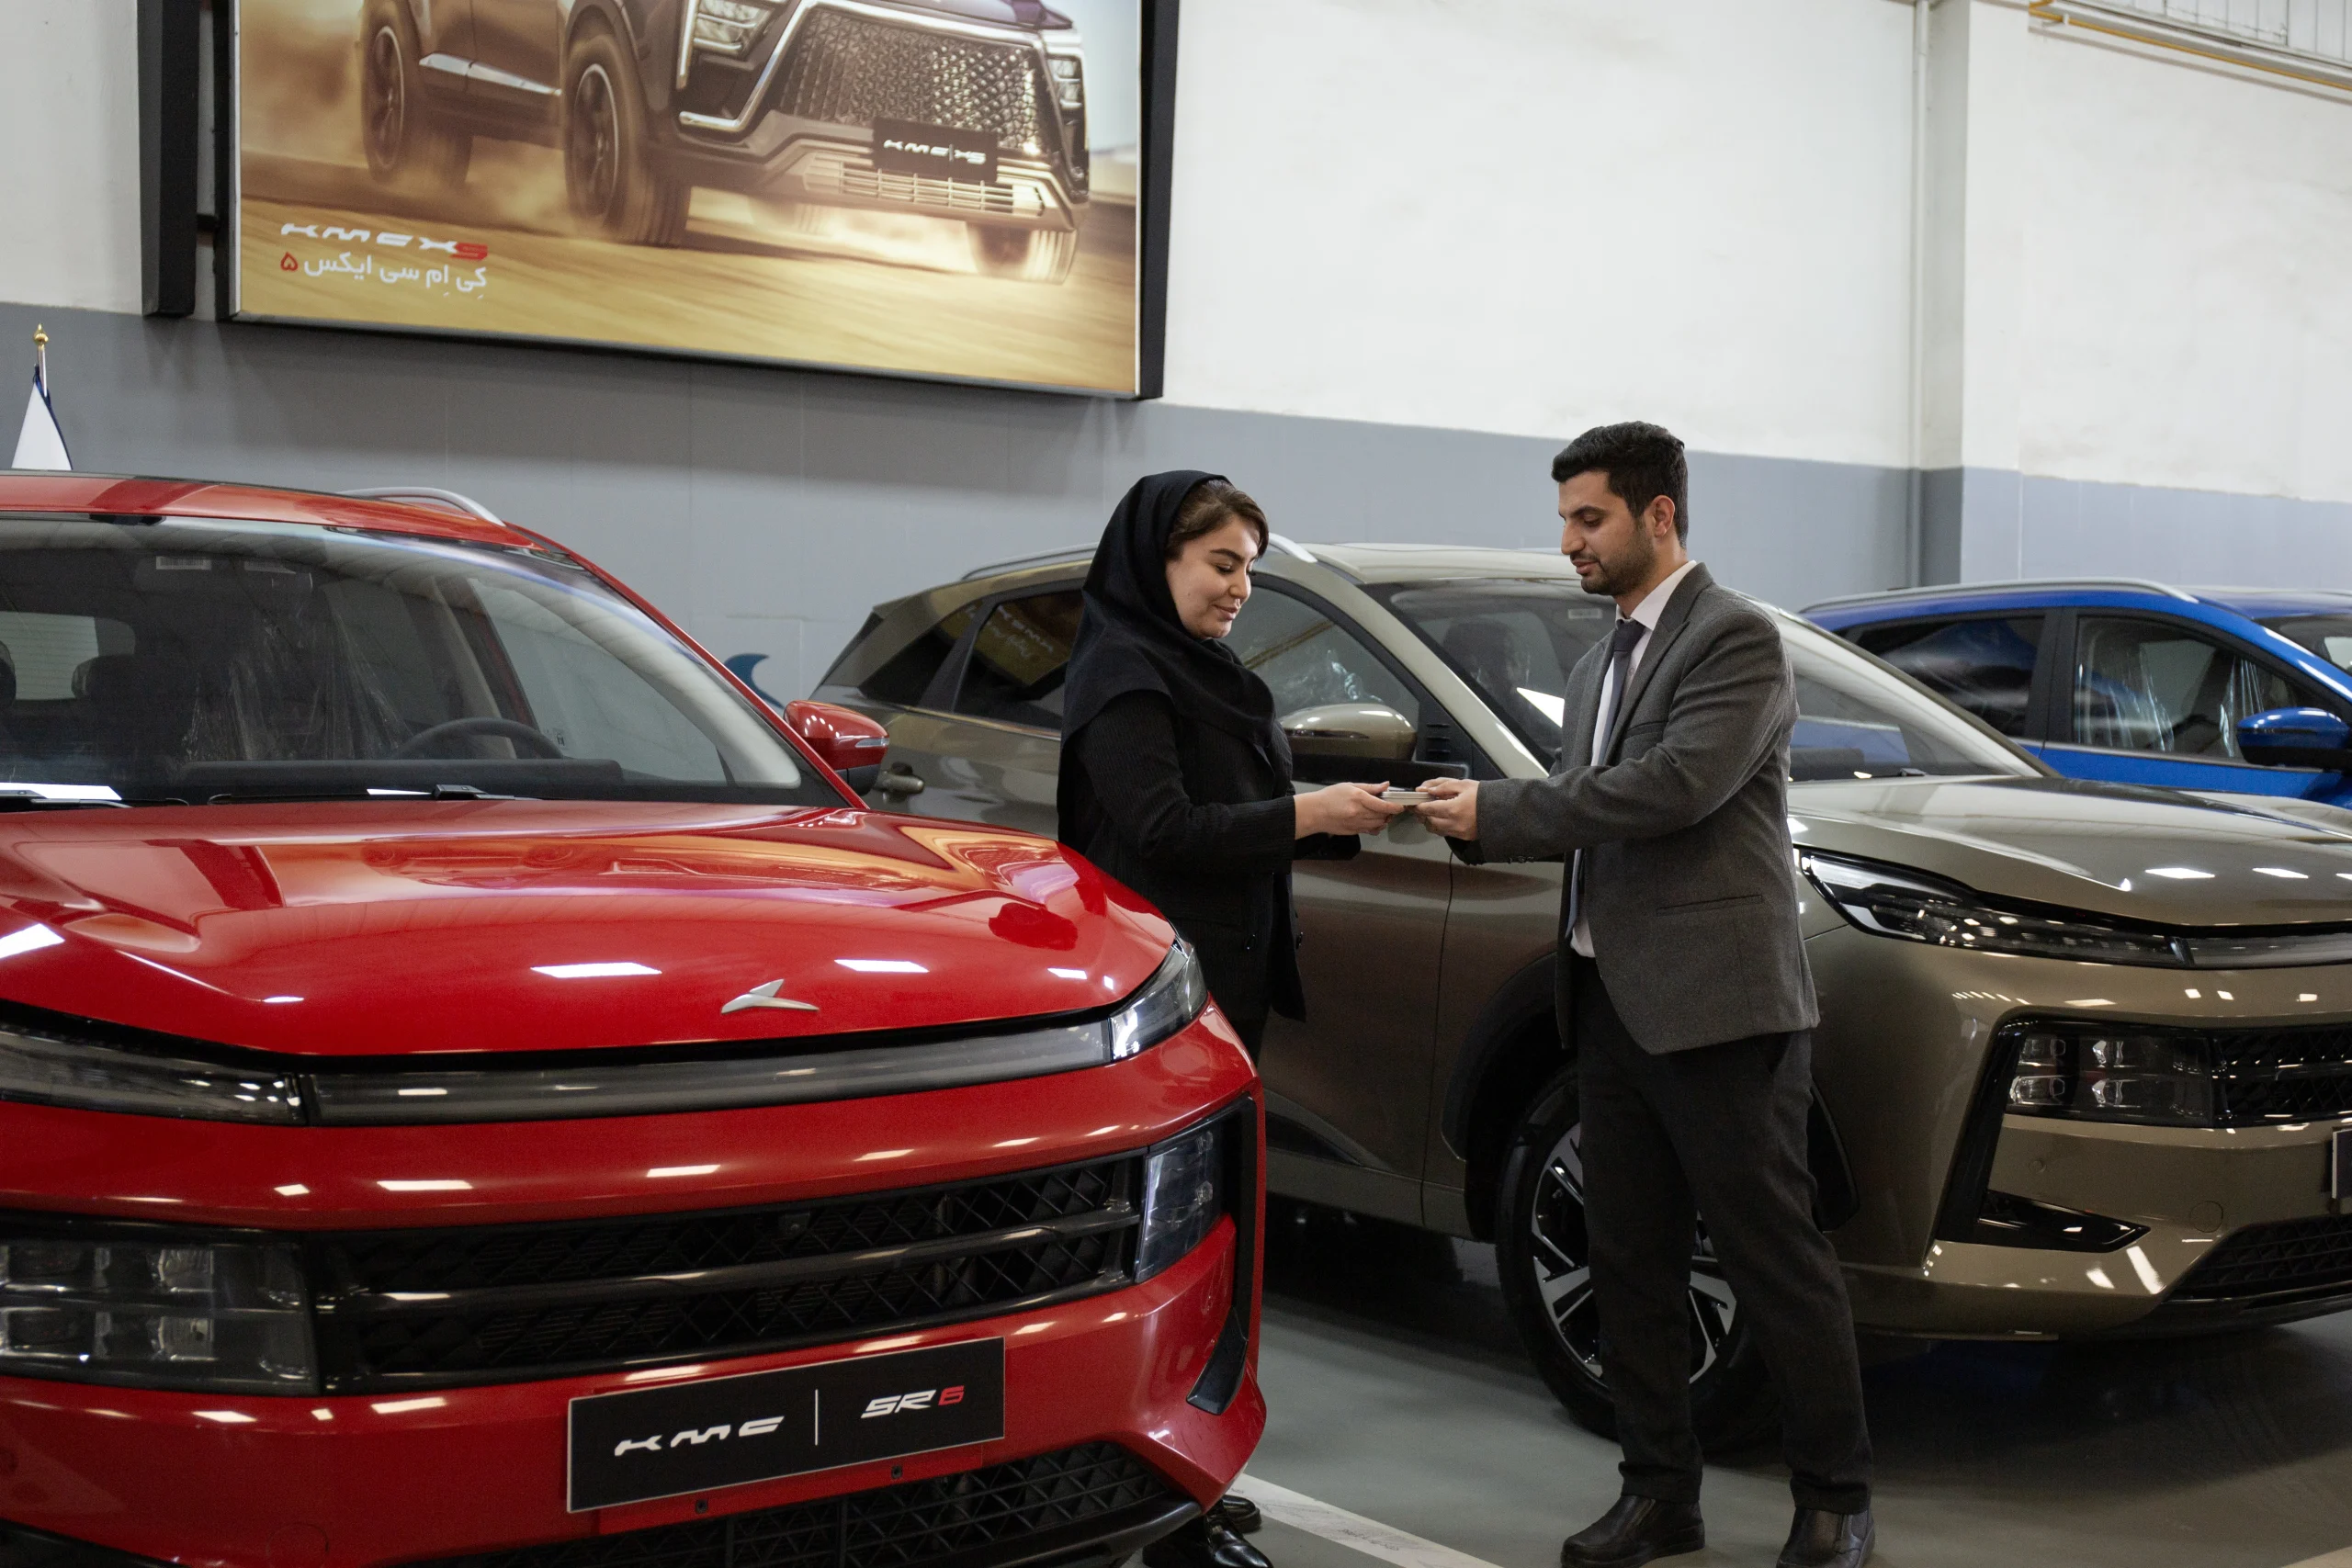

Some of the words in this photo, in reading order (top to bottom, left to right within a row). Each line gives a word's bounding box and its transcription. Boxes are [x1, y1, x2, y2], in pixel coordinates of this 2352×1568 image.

[280, 252, 299, 271] ۵
[304, 252, 372, 280] ایکس
[379, 267, 420, 284] سی
[614, 1416, 786, 1457] KMC
[860, 1385, 965, 1419] SR6
